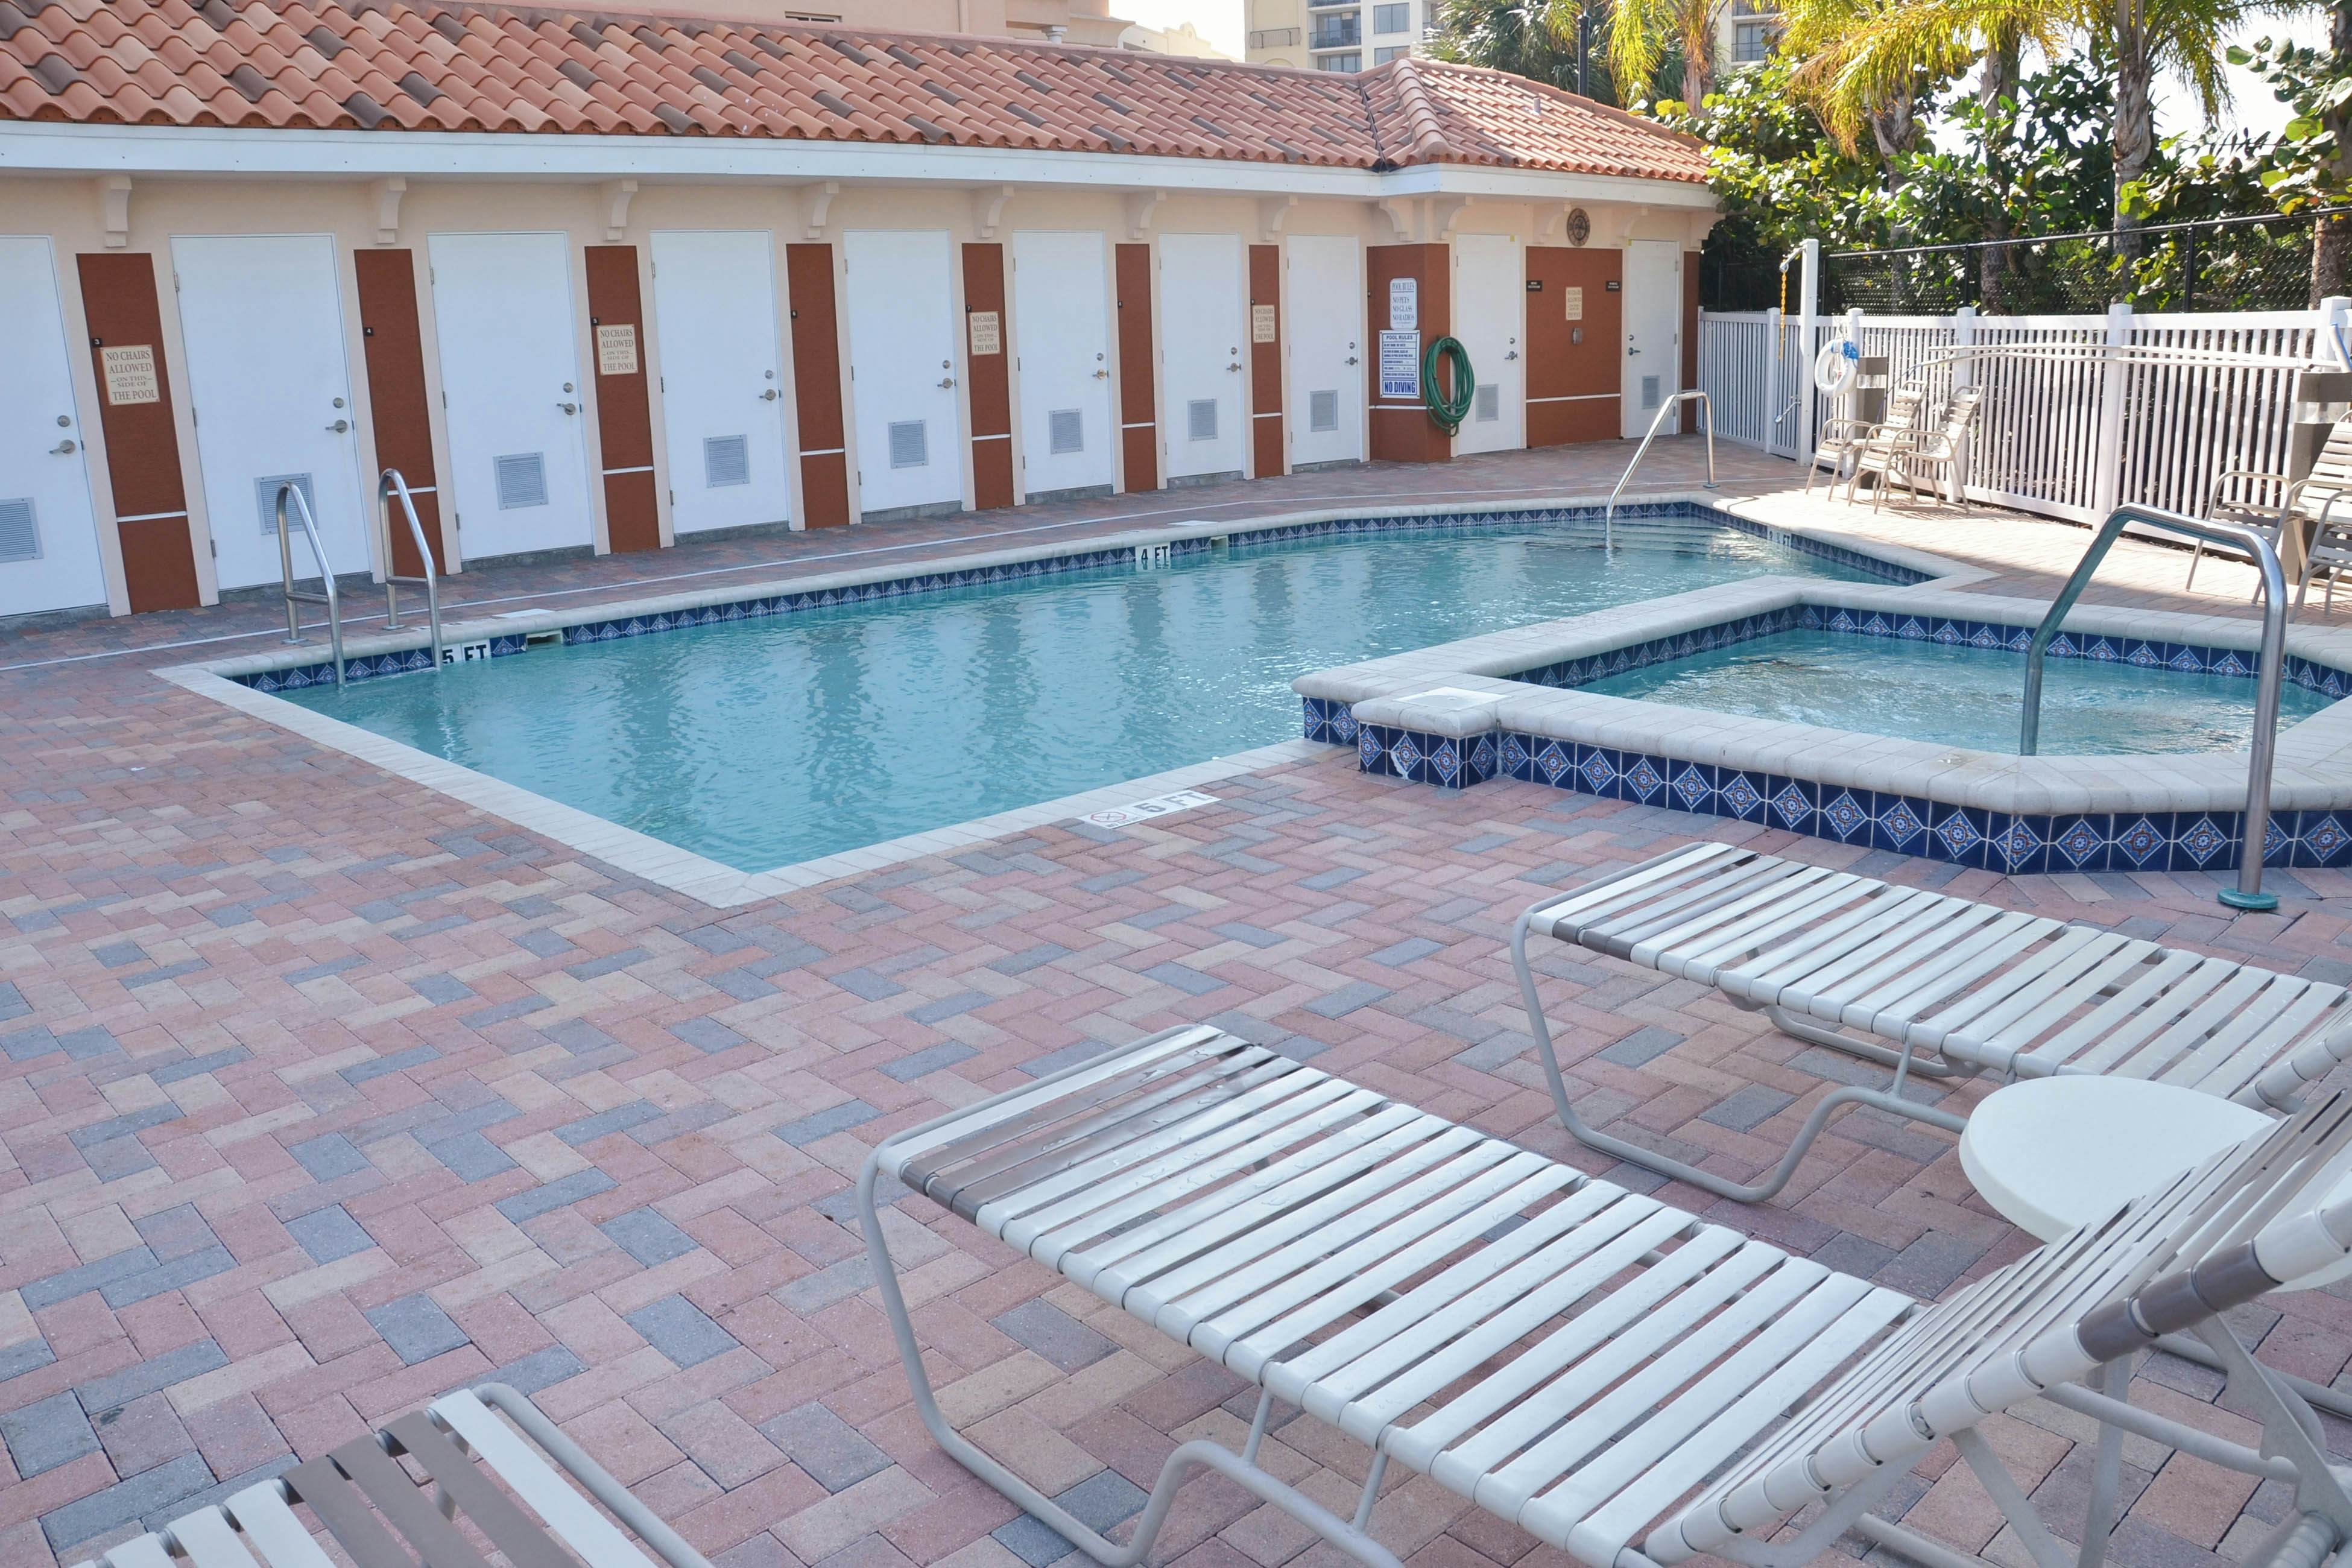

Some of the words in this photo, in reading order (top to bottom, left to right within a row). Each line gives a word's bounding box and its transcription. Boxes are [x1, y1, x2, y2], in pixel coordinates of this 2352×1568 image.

[611, 329, 632, 337] CHAIRS
[602, 340, 633, 348] ALLOWED
[106, 352, 119, 361] NO
[121, 350, 150, 361] CHAIRS
[109, 363, 152, 374] ALLOWED
[603, 363, 617, 371] THE
[618, 362, 636, 370] POOL
[1385, 381, 1393, 393] NO
[1394, 381, 1415, 393] DIVING
[112, 391, 131, 400] THE
[133, 390, 157, 400] POOL
[1142, 548, 1148, 560] 4
[1155, 546, 1168, 561] FT
[442, 649, 454, 663] 5
[464, 644, 487, 661] FT
[1133, 803, 1166, 813] 5
